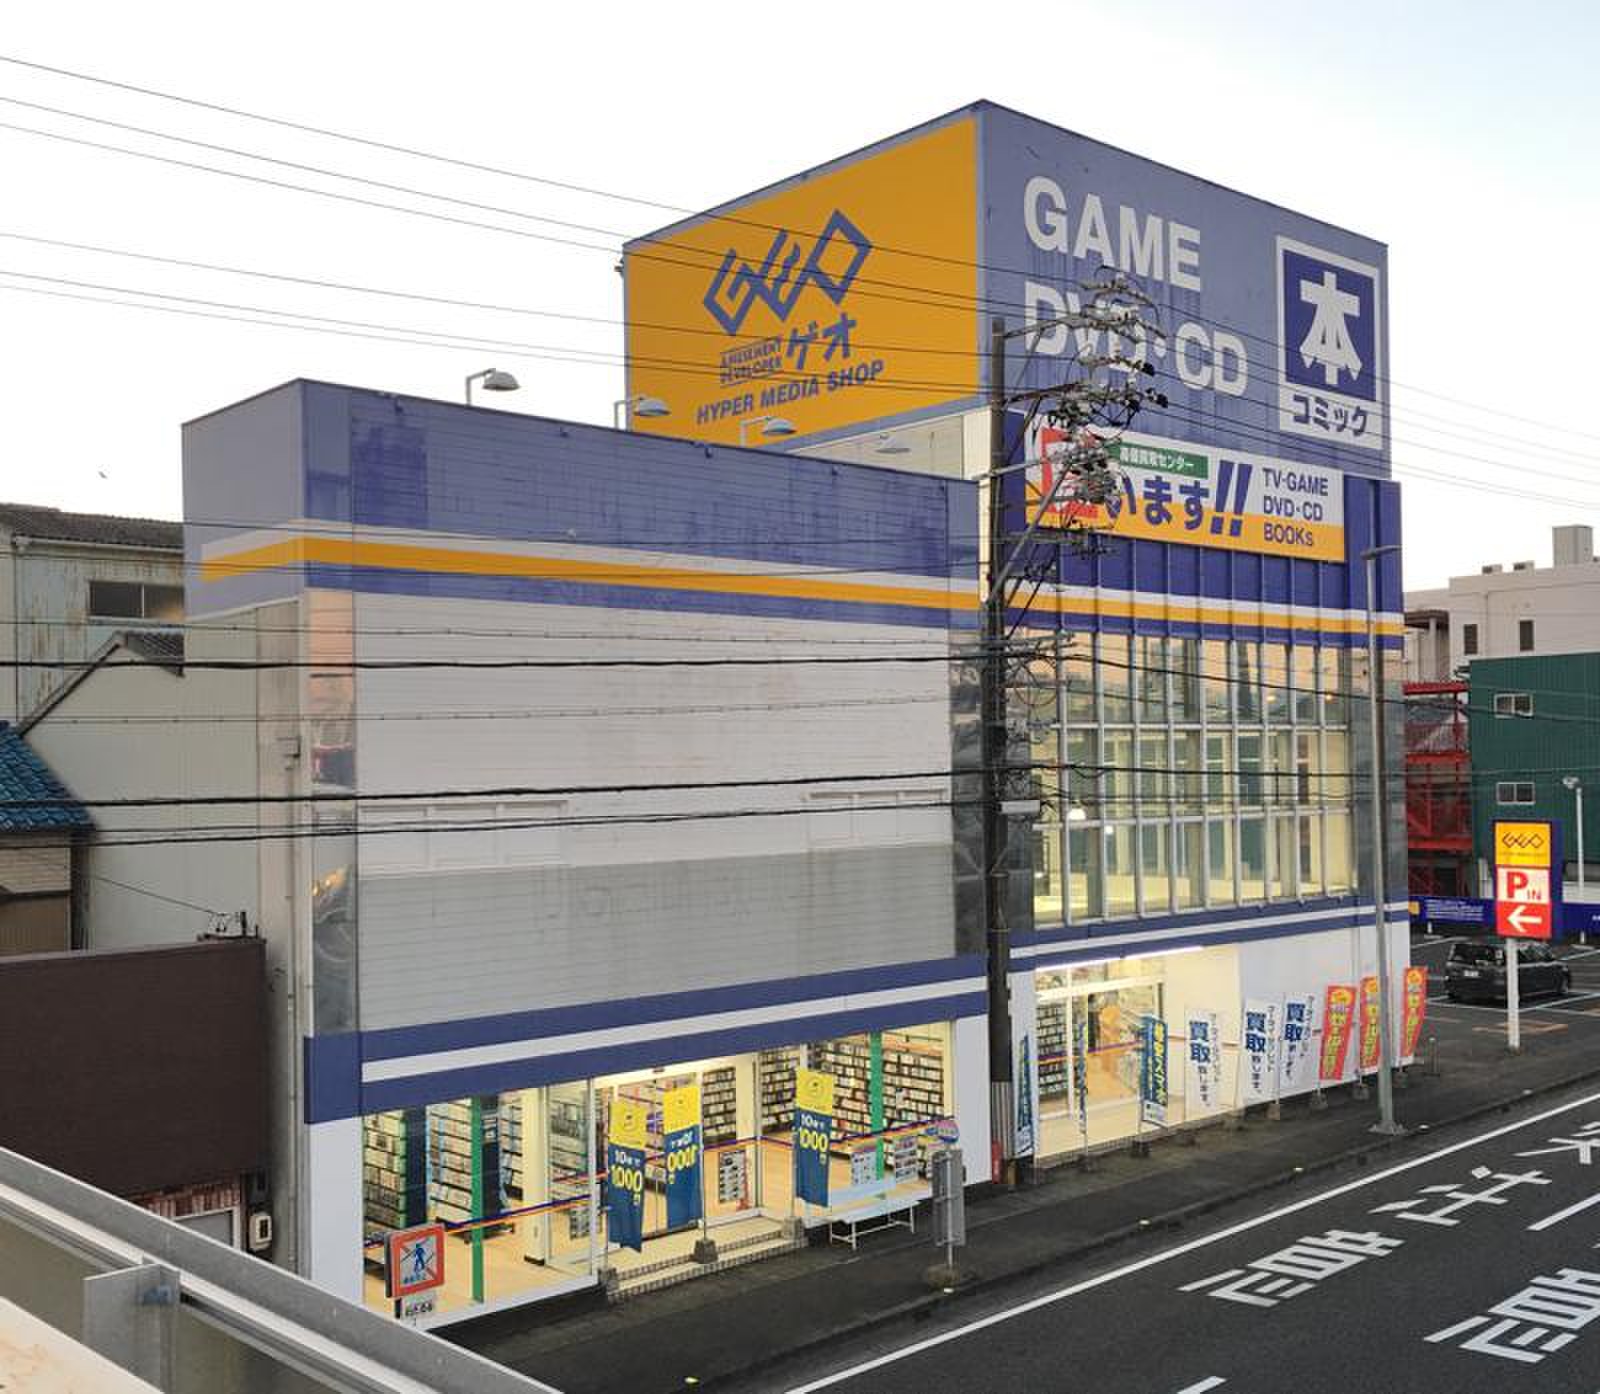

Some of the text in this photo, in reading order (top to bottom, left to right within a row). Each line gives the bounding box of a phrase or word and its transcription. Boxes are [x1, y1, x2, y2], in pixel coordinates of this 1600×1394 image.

[1024, 176, 1201, 292] GAME
[785, 312, 856, 371] ゲオ
[1299, 271, 1363, 385] 本
[697, 359, 884, 424] HYPER MEDIA SHOP
[1293, 394, 1368, 437] コミック
[1507, 871, 1529, 899] P
